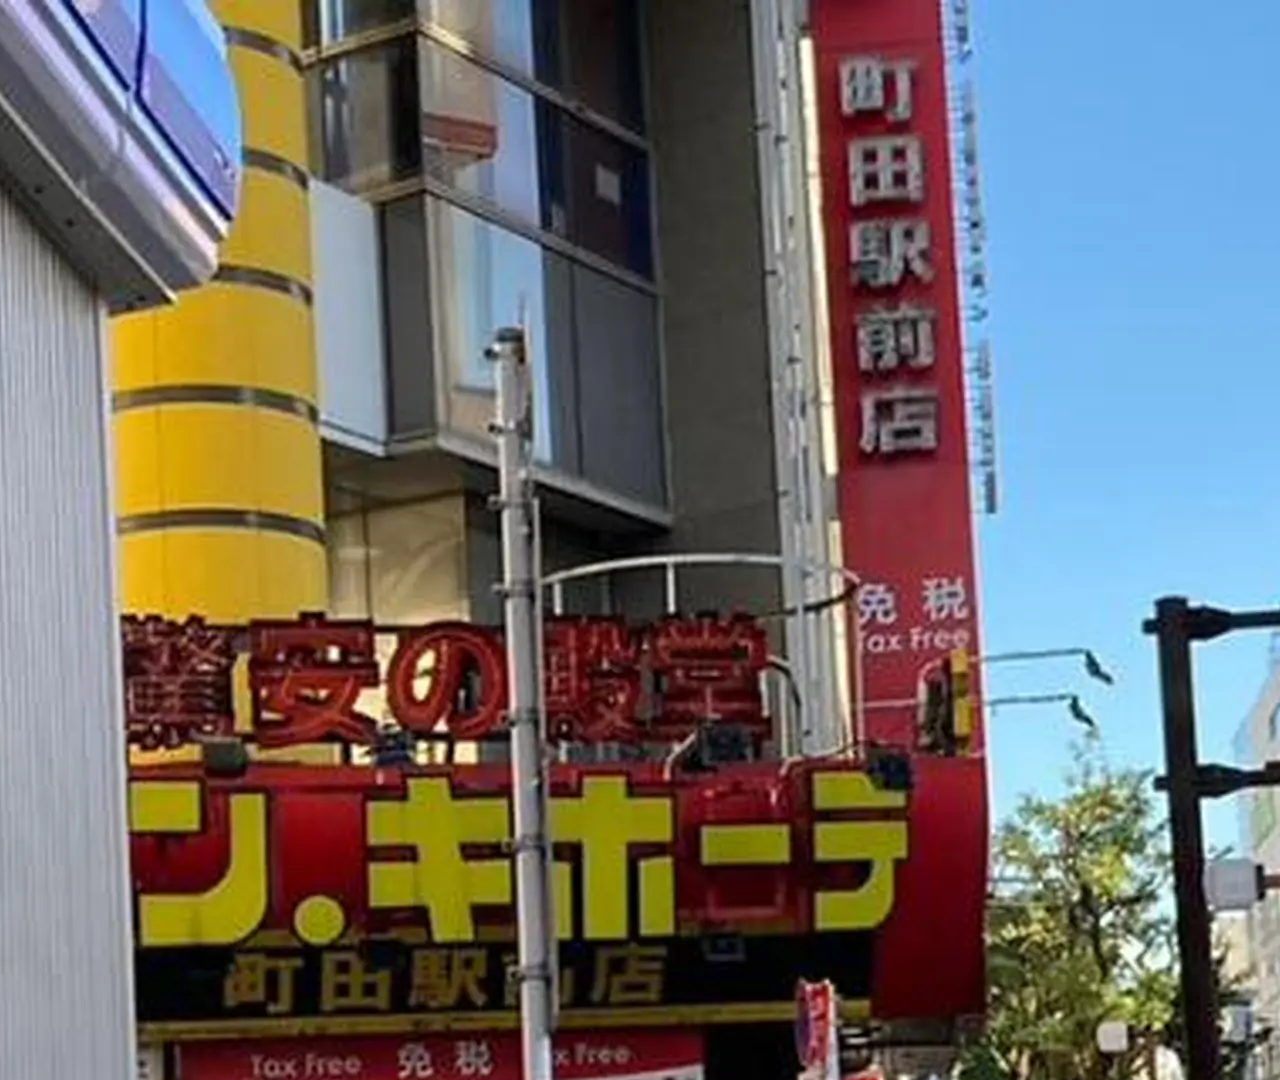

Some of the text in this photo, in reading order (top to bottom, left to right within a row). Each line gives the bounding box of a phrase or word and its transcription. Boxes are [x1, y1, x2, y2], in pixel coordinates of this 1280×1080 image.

[837, 52, 942, 458] 町田駅前店
[909, 627, 970, 652] Free
[120, 612, 770, 748] 驚安の殿堂
[251, 1055, 297, 1078] Tax
[304, 1053, 363, 1077] Free
